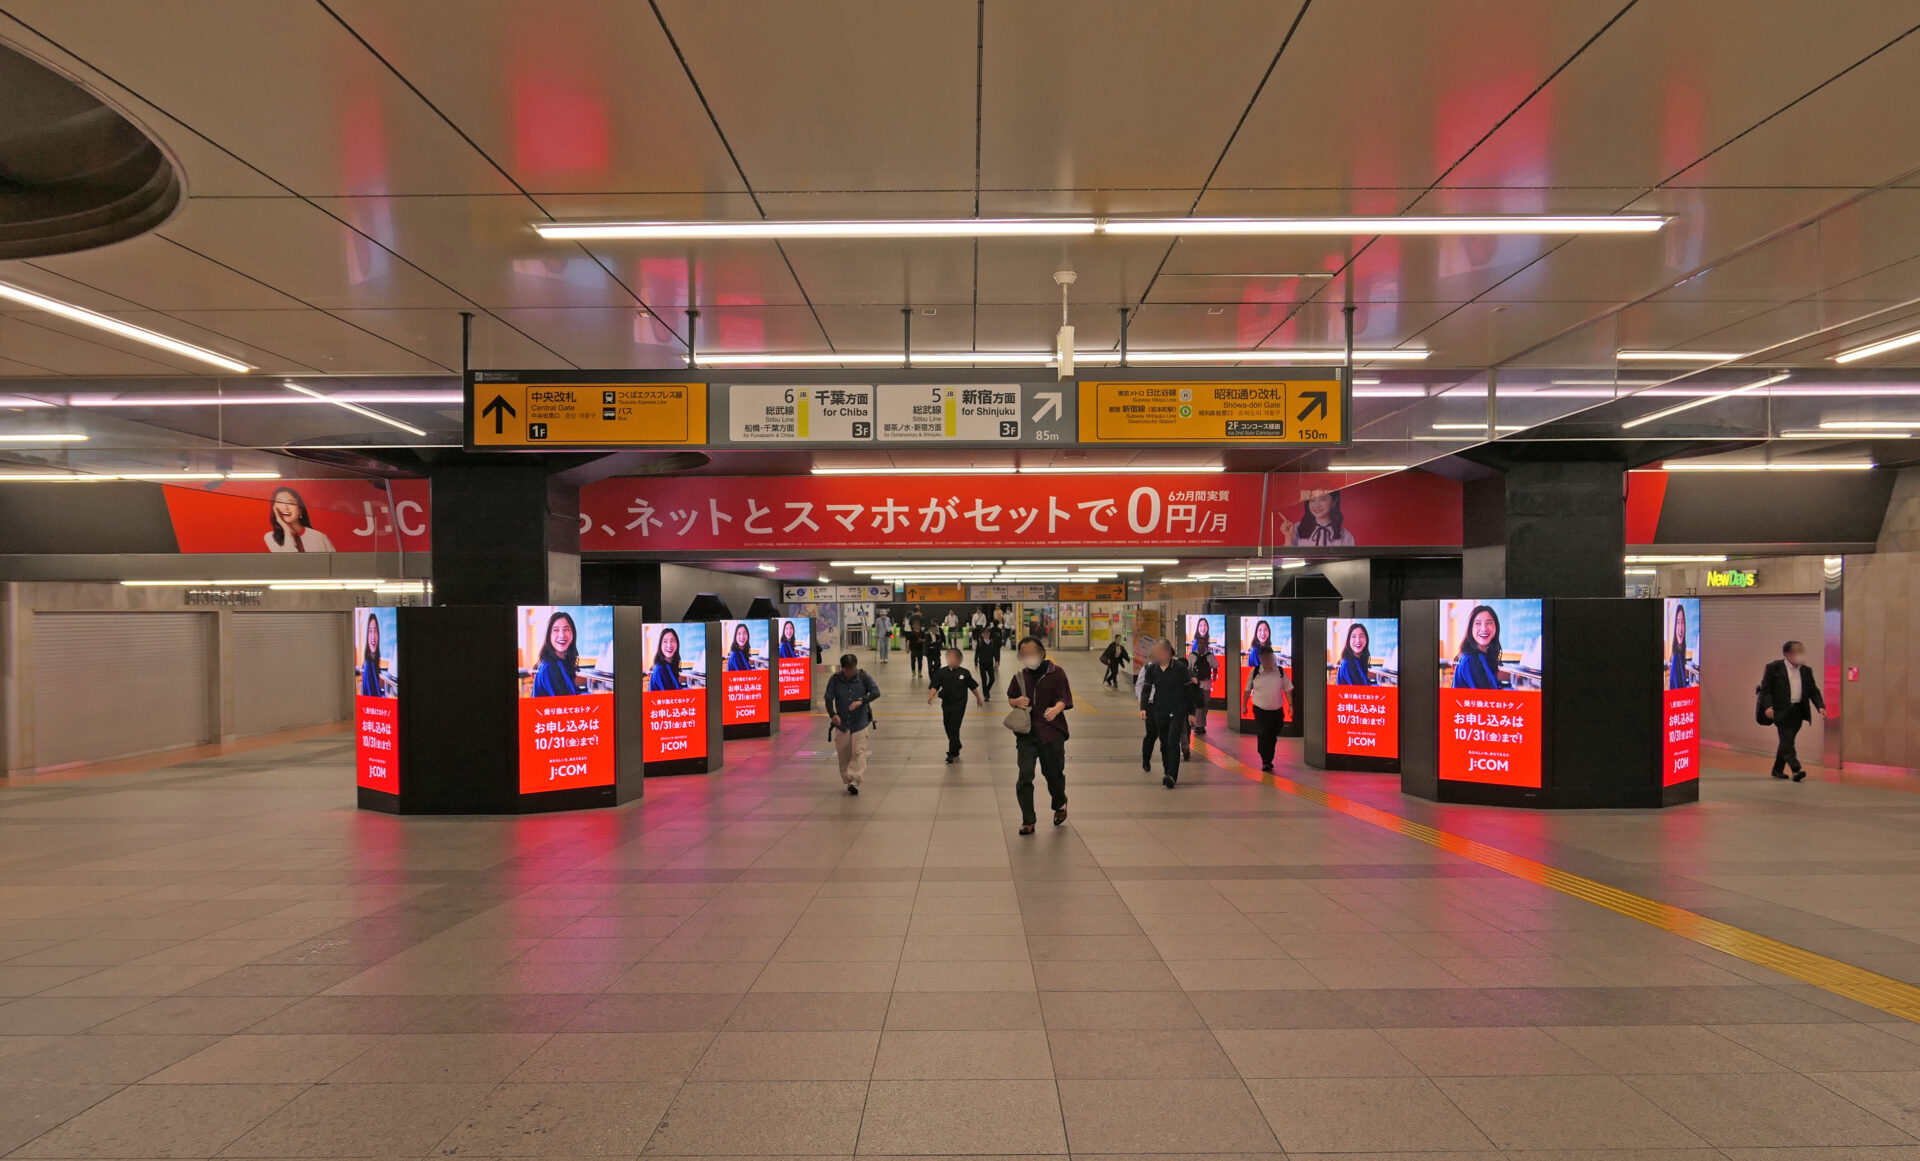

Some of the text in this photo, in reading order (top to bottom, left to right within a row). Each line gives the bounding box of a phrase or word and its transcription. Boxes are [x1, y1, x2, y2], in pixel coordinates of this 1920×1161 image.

[531, 391, 577, 403] 中央改札
[618, 391, 683, 399] つくばエクスプレス線
[784, 389, 794, 403] 6
[815, 390, 868, 405] 千葉方面
[932, 388, 941, 402] 5
[962, 389, 1016, 404] 新宿方面
[1215, 389, 1280, 400] 昭和通り改札
[618, 407, 632, 415] バス
[765, 406, 794, 415] 総武線
[823, 408, 868, 416] for Chiba
[913, 405, 942, 415] 総武線
[962, 407, 1016, 417] for Shinjuku
[532, 425, 546, 437] 1F
[854, 424, 868, 436] 3F
[884, 423, 942, 432] 御茶ノ水・新宿方面
[1002, 423, 1016, 435] 3F
[1228, 422, 1238, 430] 2F
[1036, 430, 1059, 440] 85m
[1298, 430, 1328, 440] 150m
[1168, 490, 1230, 502] 6カ月間実質
[1707, 570, 1754, 588] NewDays
[728, 684, 762, 692] お申し込みは
[1337, 703, 1386, 714] お申し込みは
[1464, 699, 1514, 709] 乗り換えておトク
[544, 706, 591, 715] 乗り換えておトク
[650, 707, 696, 719] お申し込みは
[736, 709, 756, 718] J:COM
[1454, 712, 1524, 727] お申し込みは
[534, 719, 599, 734] お申し込みは
[535, 734, 599, 750] 10/31(金)まで!
[1347, 736, 1376, 747] J:COM
[1454, 728, 1523, 744] 10/31(金)まで!
[661, 741, 687, 753] J:COM
[1468, 758, 1509, 771] J:COM
[369, 765, 386, 778] J:COM
[549, 763, 587, 780] J:COM
